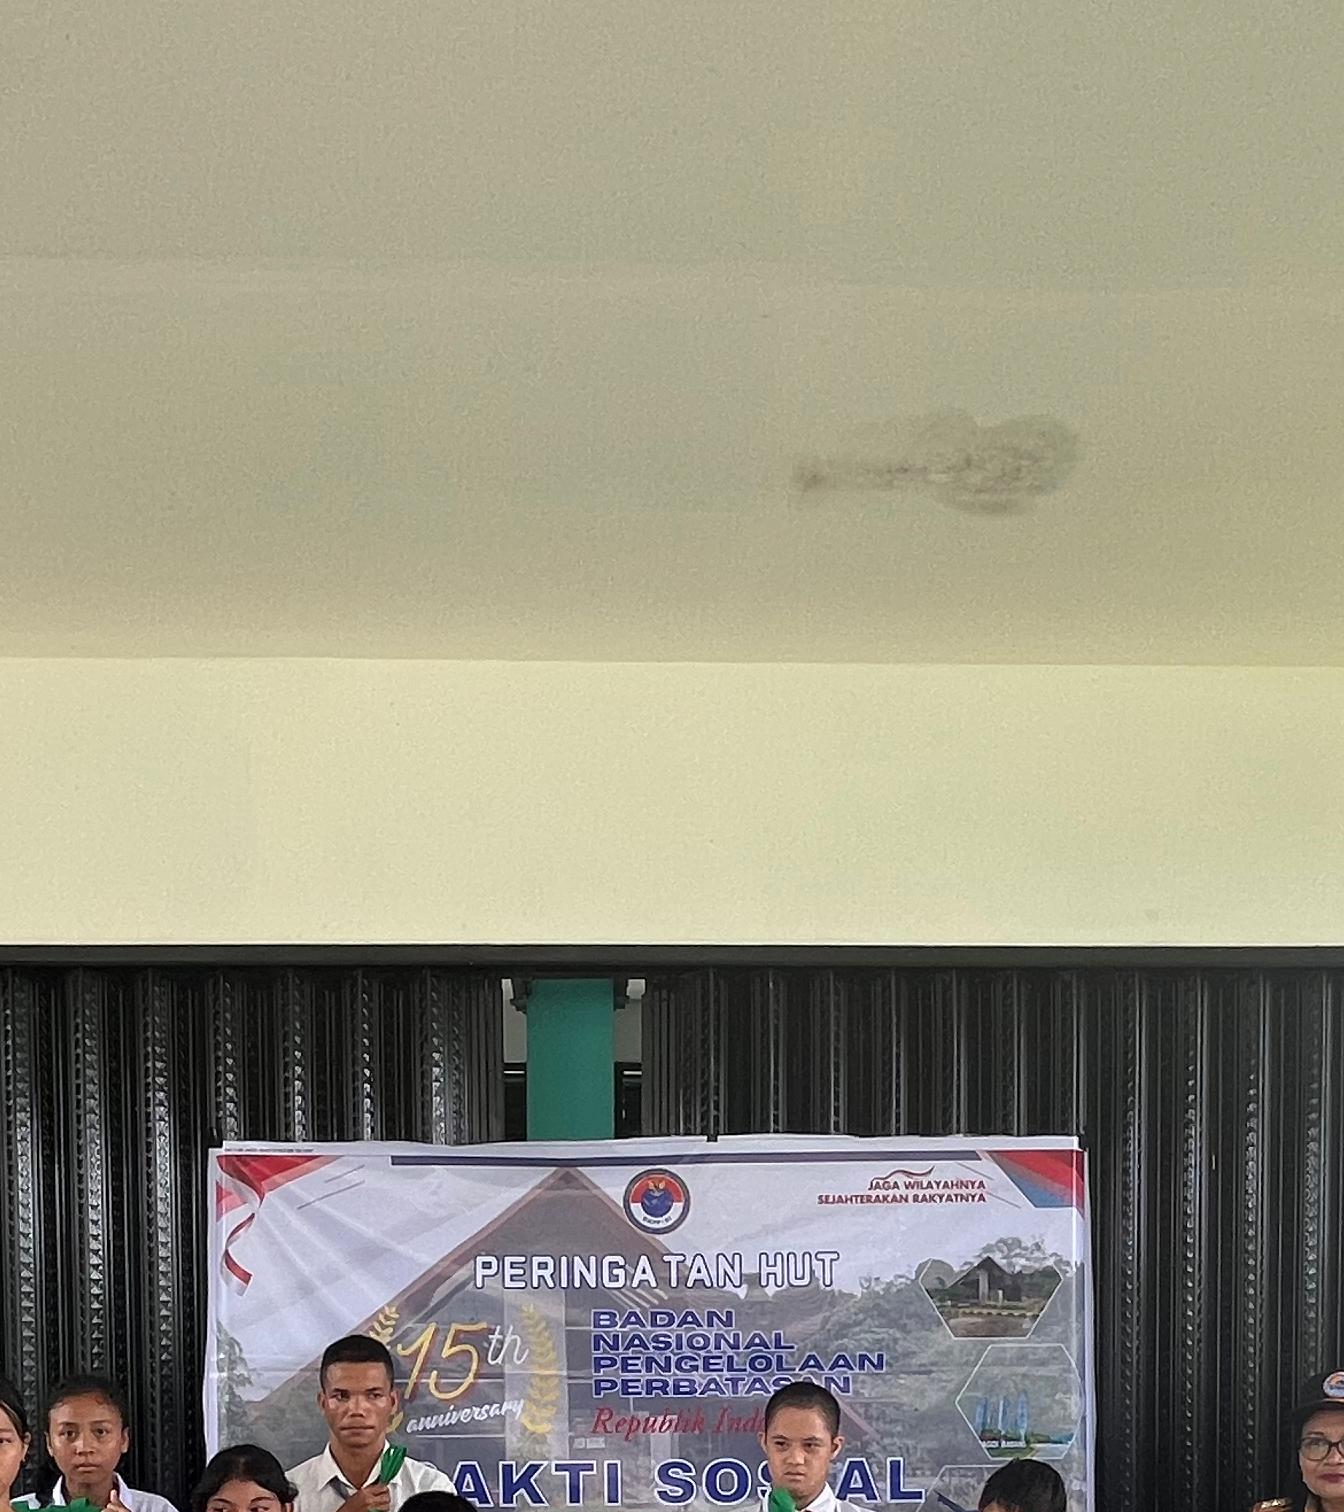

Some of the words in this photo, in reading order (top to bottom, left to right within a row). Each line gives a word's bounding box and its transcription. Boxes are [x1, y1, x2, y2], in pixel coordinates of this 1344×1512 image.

[868, 1180, 900, 1192] JAGA
[905, 1179, 986, 1191] WILAYAHNYA
[817, 1194, 909, 1205] SEJAHTERAKAN
[912, 1193, 986, 1204] RAKYATNYA
[474, 1253, 744, 1289] PERINGATAN
[759, 1251, 840, 1288] HUT
[592, 1309, 735, 1329] BADAN
[592, 1331, 796, 1352] NASIONAL
[592, 1353, 886, 1375] PENGELOLAAN
[593, 1375, 853, 1397] PERBATASN
[406, 1399, 525, 1434] anniversary
[591, 1406, 705, 1443] Republik
[454, 1460, 624, 1508] AKTI
[655, 1456, 928, 1506] SOAL
